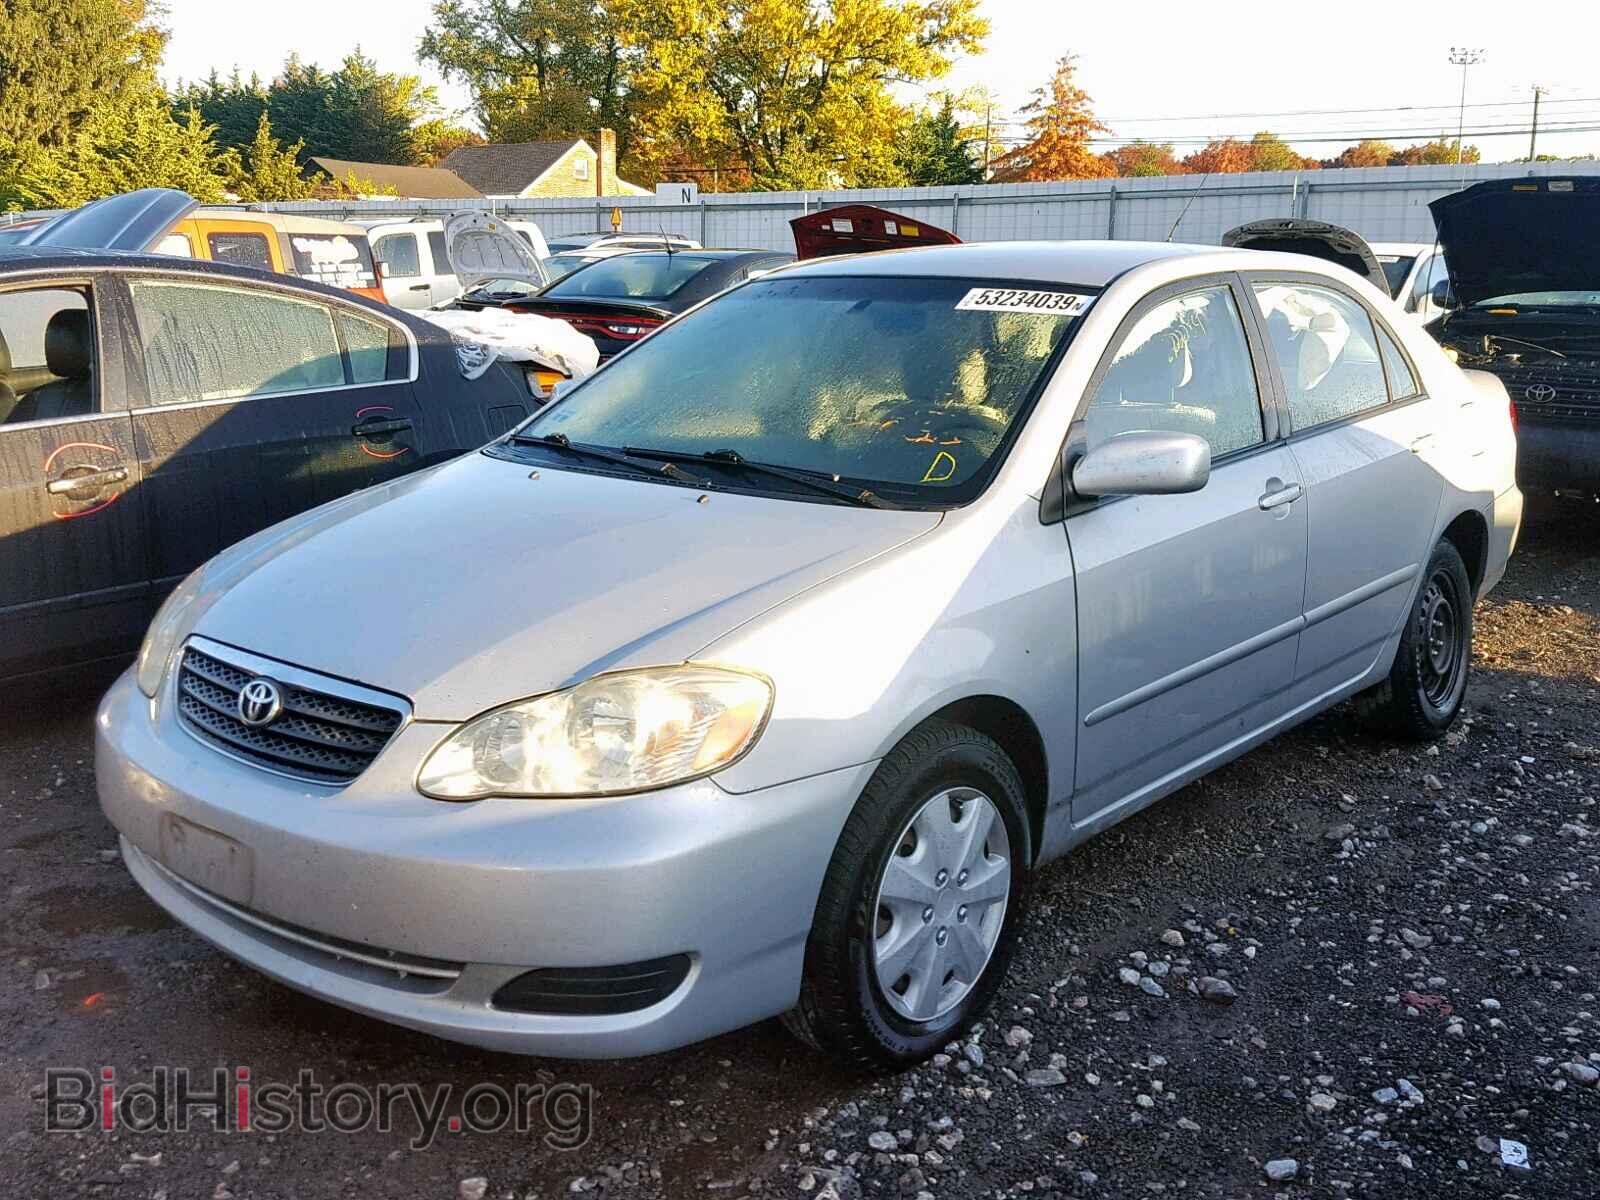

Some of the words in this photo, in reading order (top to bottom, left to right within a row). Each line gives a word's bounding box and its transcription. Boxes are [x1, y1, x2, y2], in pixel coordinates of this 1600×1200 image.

[681, 187, 691, 204] N
[975, 290, 1077, 310] 53234039
[919, 451, 956, 483] D
